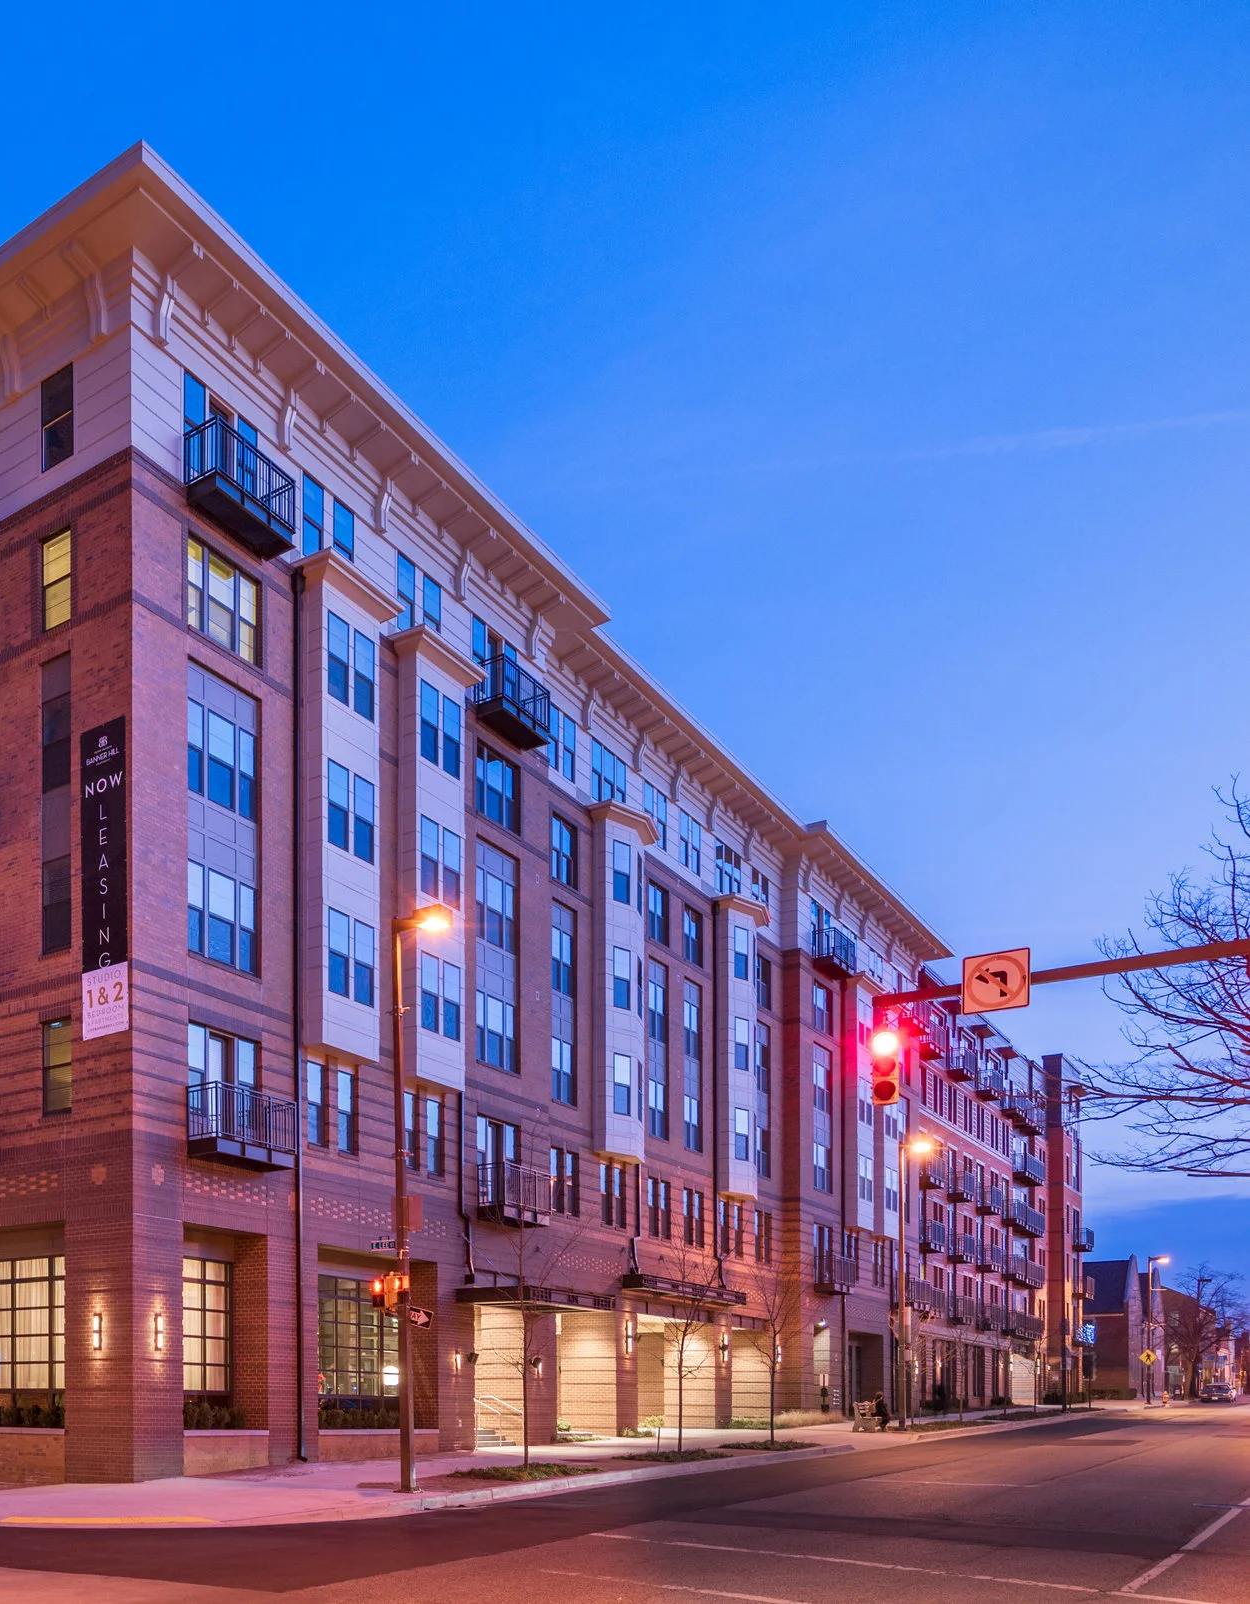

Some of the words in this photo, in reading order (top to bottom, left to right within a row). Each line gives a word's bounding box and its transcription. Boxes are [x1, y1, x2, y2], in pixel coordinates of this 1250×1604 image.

[86, 752, 108, 766] BANNER
[108, 747, 120, 759] HILL
[85, 771, 123, 799] NOW
[98, 804, 110, 968] LEASING
[87, 989, 93, 1008] 1
[97, 987, 109, 1006] &
[113, 981, 124, 1002] 2
[87, 1004, 124, 1020] BEDROOM
[87, 1012, 124, 1027] APARTMENTS
